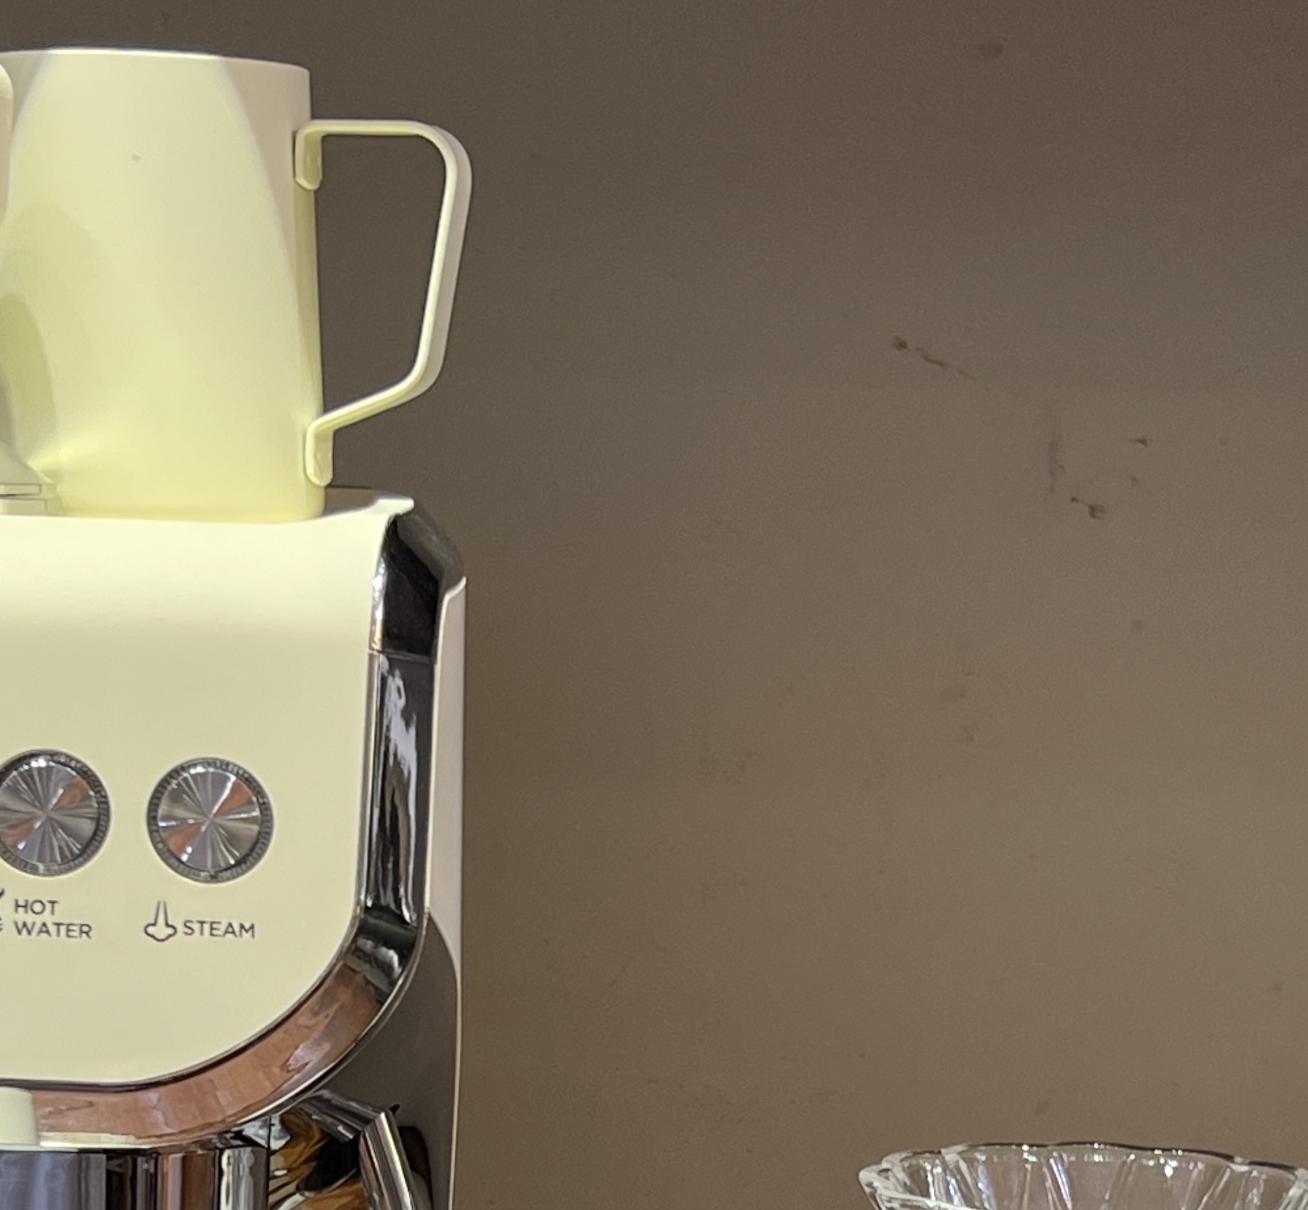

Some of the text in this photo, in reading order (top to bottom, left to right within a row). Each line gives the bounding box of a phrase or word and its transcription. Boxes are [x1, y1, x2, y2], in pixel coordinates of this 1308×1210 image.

[13, 897, 60, 917] HOT
[13, 919, 93, 940] WATER
[182, 919, 256, 940] STEAM
